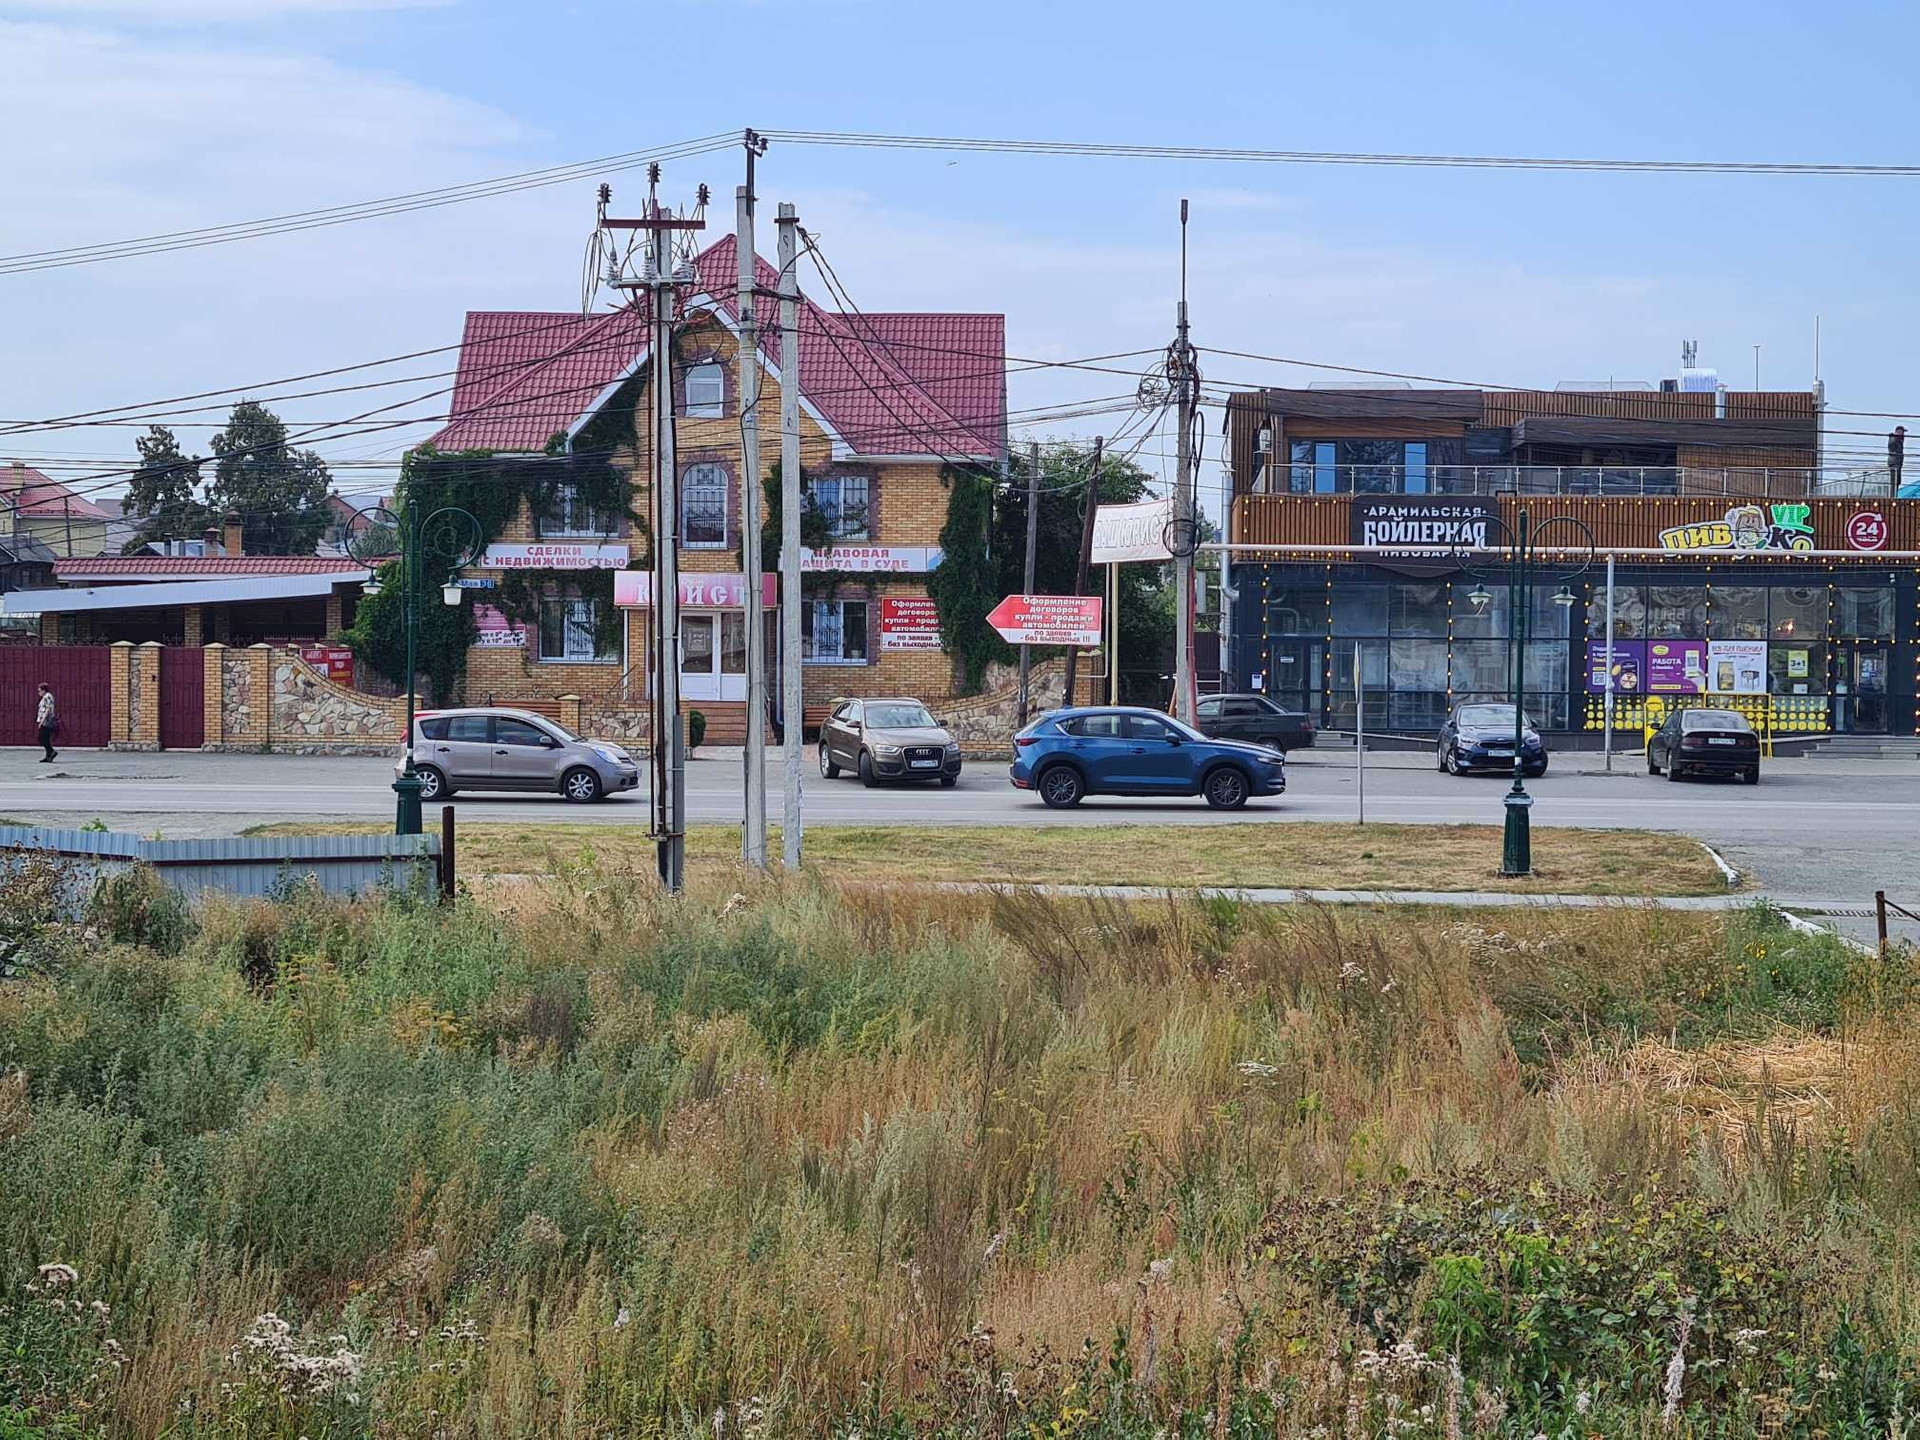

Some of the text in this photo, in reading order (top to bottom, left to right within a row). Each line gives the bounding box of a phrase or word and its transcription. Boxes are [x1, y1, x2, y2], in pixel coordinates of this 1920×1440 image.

[1368, 506, 1482, 517] АРАМИЛЬСКАЯ
[1771, 505, 1811, 524] VIP
[1363, 516, 1487, 548] БОЙЛЕРНАЯ
[1856, 522, 1878, 535] 24
[527, 546, 582, 556] СДЕЛКИ
[483, 557, 626, 567] С НЕДВИЖИМОСТЬЮ
[801, 560, 909, 569] АЩИТА В СУДЕ
[1023, 597, 1087, 606] Оформление
[1051, 614, 1094, 622] продажи
[1022, 621, 1085, 629] автомобилей
